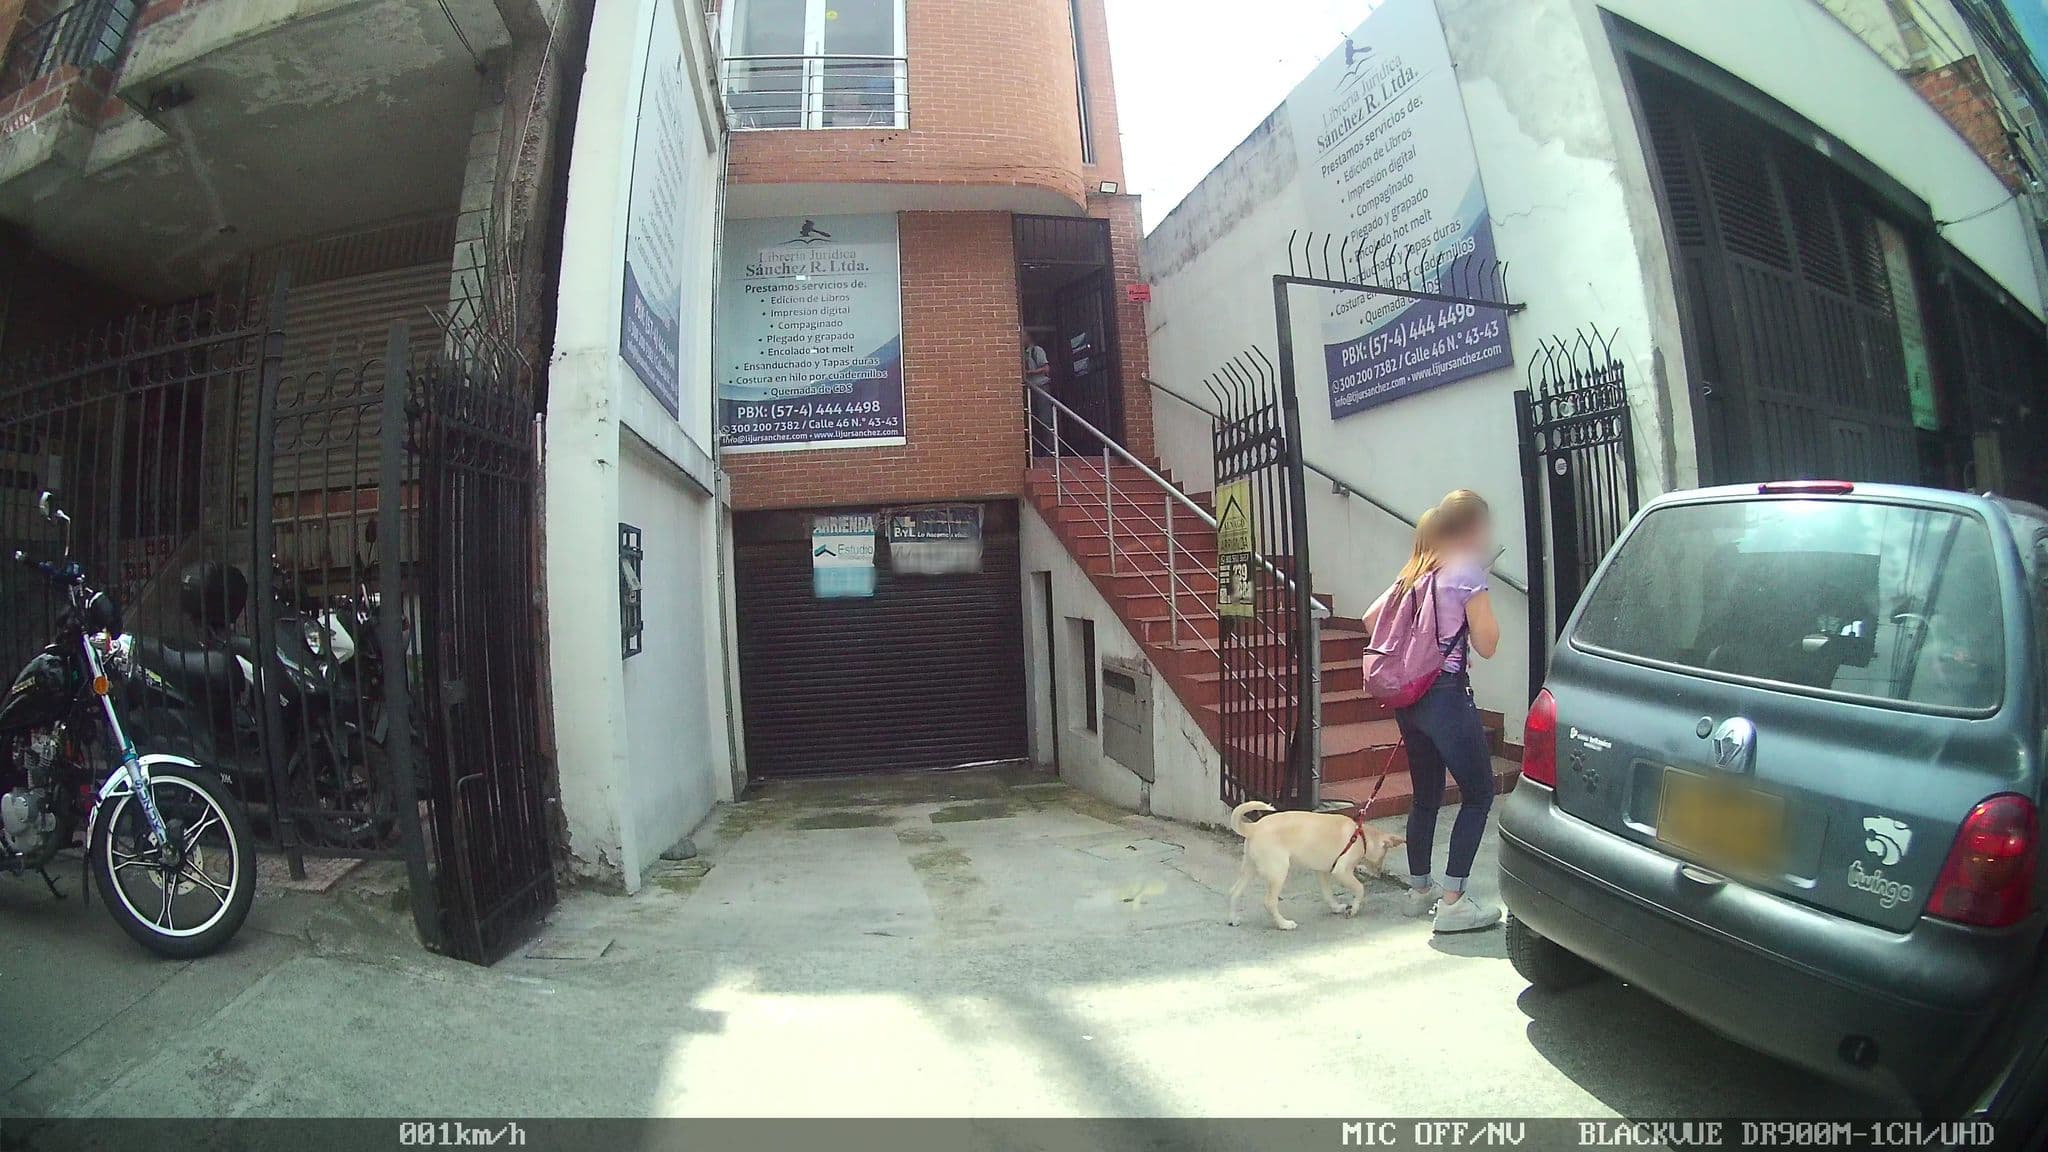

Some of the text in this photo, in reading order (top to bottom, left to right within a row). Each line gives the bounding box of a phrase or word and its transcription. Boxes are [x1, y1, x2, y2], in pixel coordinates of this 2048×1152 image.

[1364, 94, 1380, 114] R.
[1381, 66, 1418, 101] Ltda.
[1321, 96, 1423, 178] Prestamos servicios de:
[1373, 147, 1385, 161] de
[1385, 128, 1412, 153] Libros
[1388, 144, 1417, 172] digital
[1356, 173, 1414, 217] Compaginado
[1350, 188, 1428, 242] Plegado y grapado
[1393, 223, 1411, 240] hot
[1410, 209, 1432, 228] melt
[1403, 236, 1431, 255] Tapas
[1433, 219, 1461, 241] duras
[746, 259, 869, 277] Sánchez R. Ltda.
[1335, 293, 1365, 316] Costura
[1413, 237, 1475, 275] cuadernillos
[745, 279, 867, 294] Prestamos servicios de:
[807, 295, 819, 303] de
[821, 293, 850, 302] Libros
[820, 306, 850, 317] digital
[1365, 295, 1406, 323] Quemada
[778, 319, 843, 331] Compaginado
[1342, 303, 1475, 368] PBX: (57-4) 444 4498
[767, 334, 805, 344] Plegado
[815, 332, 855, 344] grapado
[768, 347, 811, 357] Encolado
[832, 345, 854, 354] melt
[1340, 374, 1355, 392] 300
[1356, 368, 1373, 386] 200
[1375, 358, 1397, 379] 7382
[1405, 348, 1430, 366] Calle
[1432, 341, 1446, 357] 46
[1465, 320, 1499, 346] 43-43
[744, 359, 812, 371] Ensanduchado
[822, 358, 850, 369] Tapas
[852, 356, 879, 365] duras
[1411, 344, 1502, 382] www.lijursanchez.com
[736, 376, 773, 385] Costura
[789, 372, 807, 382] hilo
[809, 373, 825, 384] por
[828, 368, 888, 380] cuadernillos
[771, 383, 853, 398] Quemada de CDS
[737, 400, 881, 419] PBX: (57-4) 444 4498
[731, 422, 750, 433] 300
[753, 421, 772, 432] 200
[774, 420, 800, 431] 7382
[808, 417, 834, 429] Calle
[836, 417, 850, 428] 46
[868, 416, 898, 427] 43-43
[813, 428, 899, 440] www.lijursanchez.com
[838, 543, 874, 555] Estudio
[1848, 860, 1913, 909] twingo
